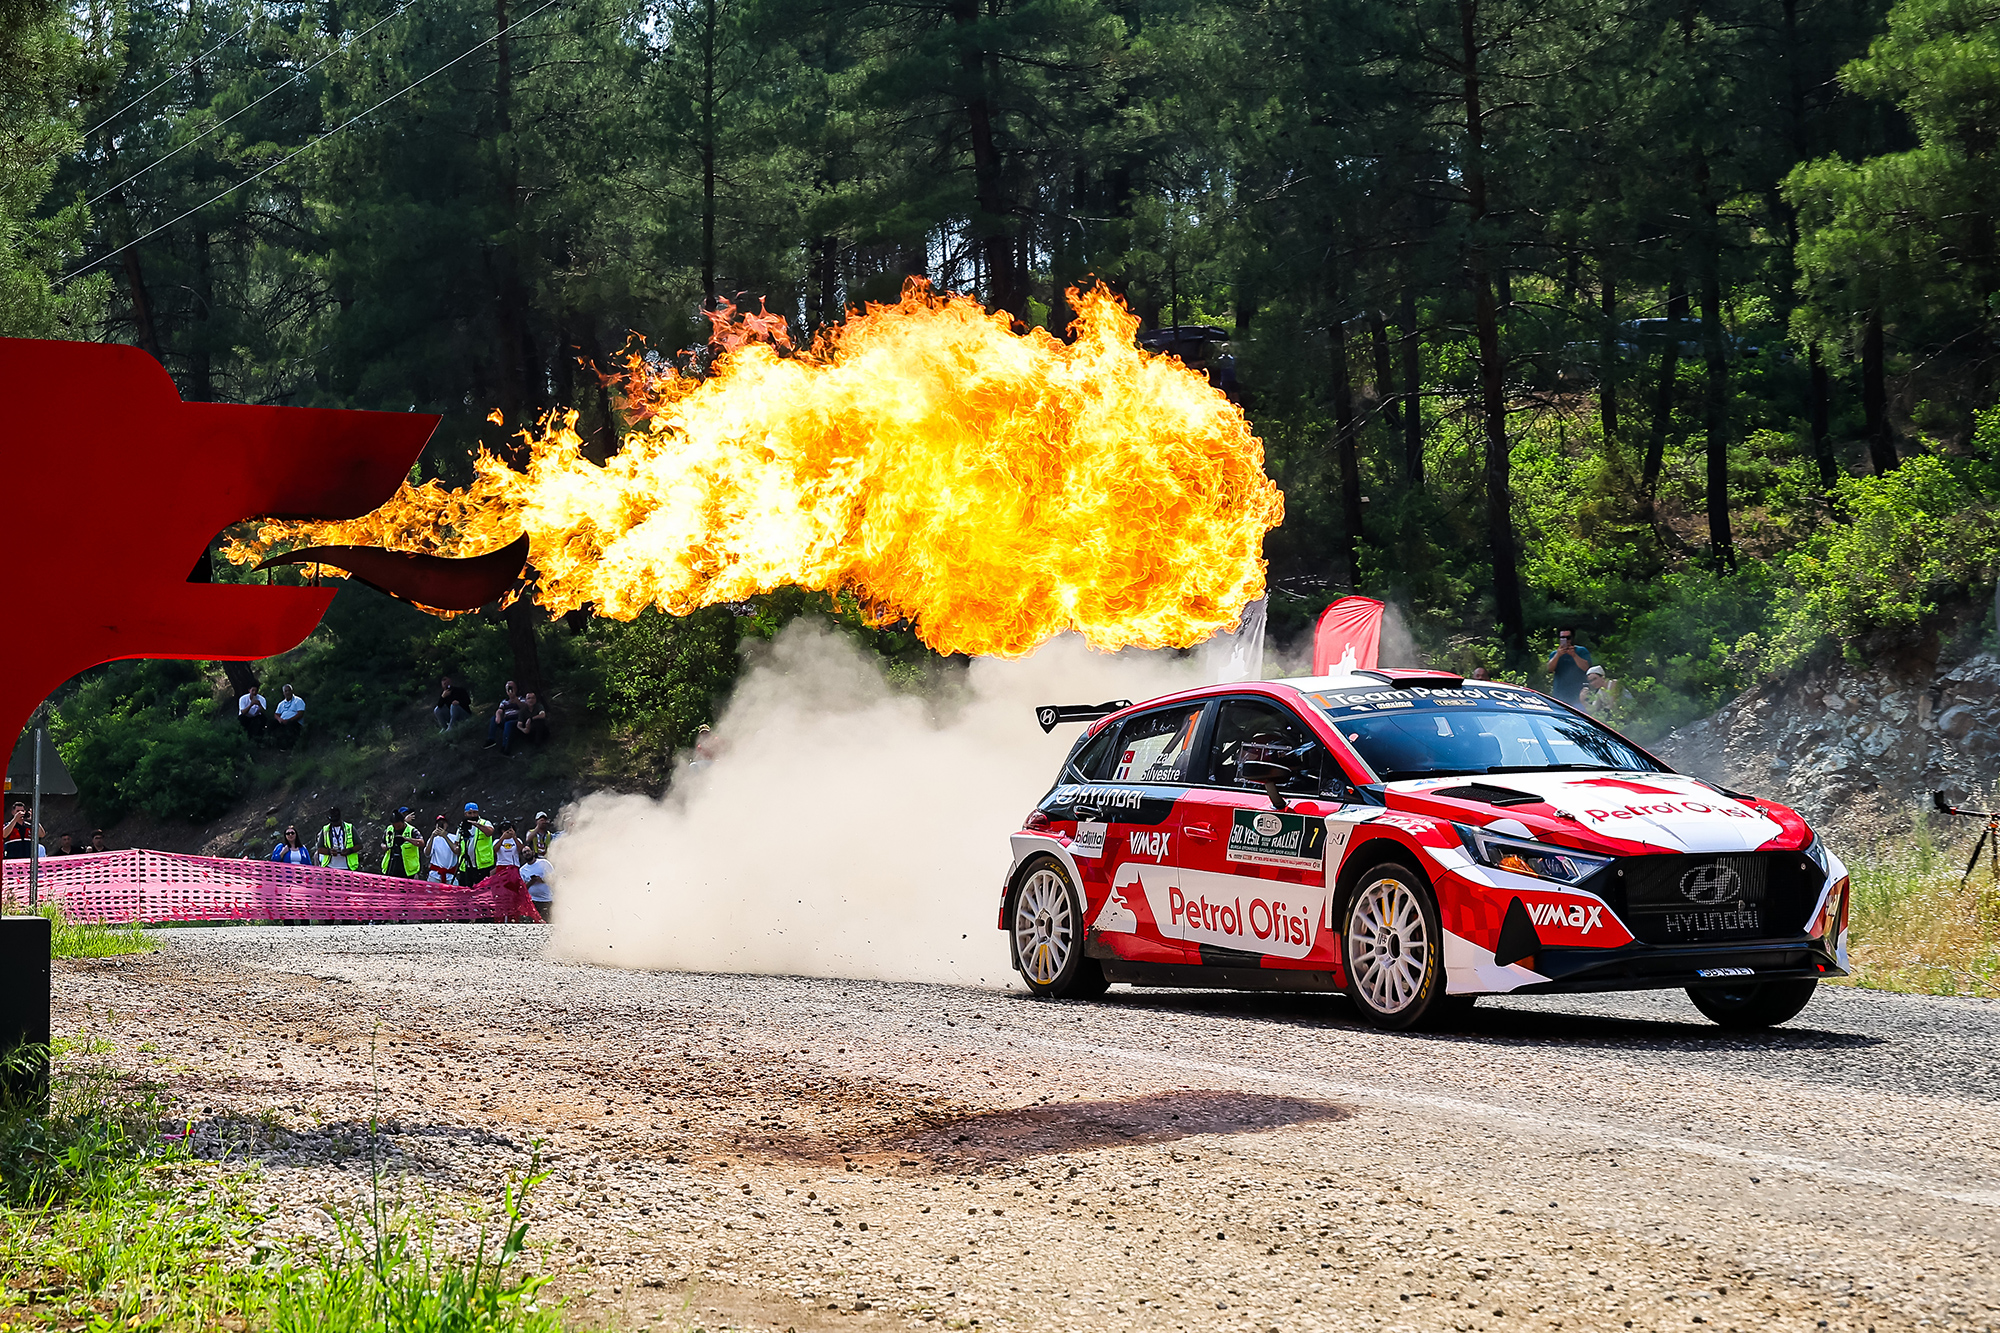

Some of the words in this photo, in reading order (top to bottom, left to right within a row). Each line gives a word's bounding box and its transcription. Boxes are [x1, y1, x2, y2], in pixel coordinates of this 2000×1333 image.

[1310, 694, 1332, 708] 1
[1326, 690, 1414, 705] Team
[1410, 687, 1489, 699] Petrol
[1182, 710, 1200, 750] 1
[1077, 787, 1146, 809] HYUNDAI
[1585, 802, 1683, 822] Petrol
[1168, 886, 1243, 936] Petrol
[1249, 898, 1311, 946] Ofisi
[1666, 911, 1759, 932] HYUNDAI
